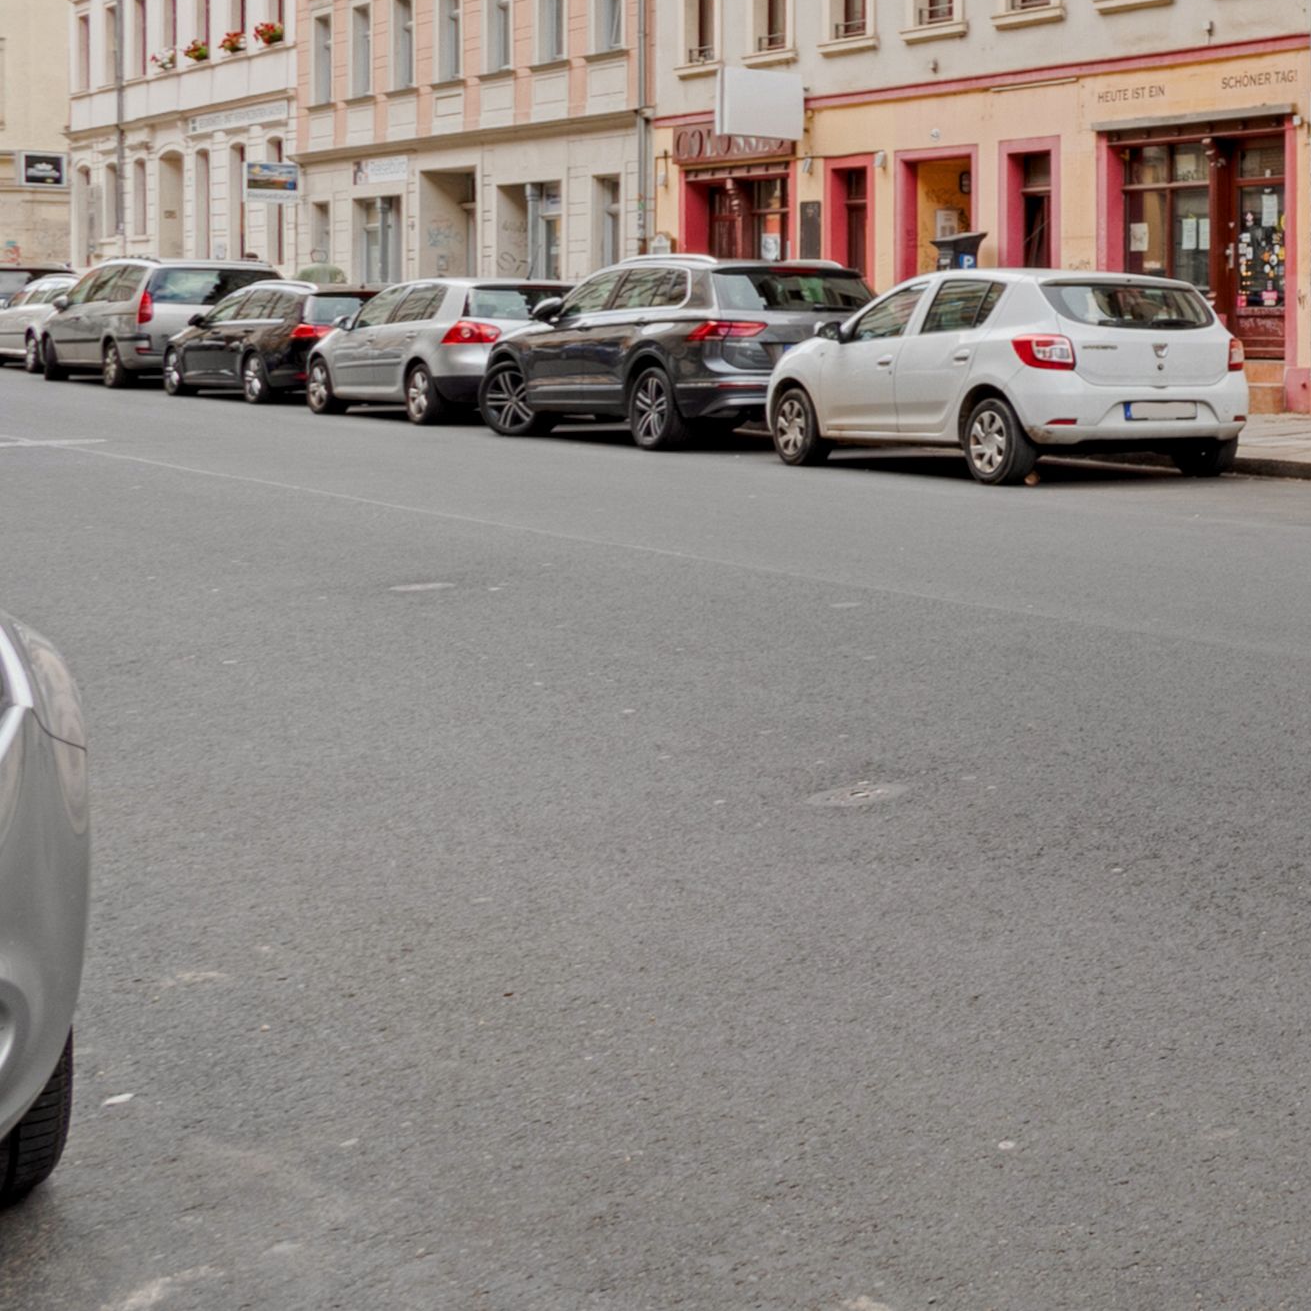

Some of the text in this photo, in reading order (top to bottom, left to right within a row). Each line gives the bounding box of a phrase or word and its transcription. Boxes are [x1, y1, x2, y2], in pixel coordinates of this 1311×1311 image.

[1098, 69, 1298, 103] HEUTE IST EIN SCHÖNER TAG!
